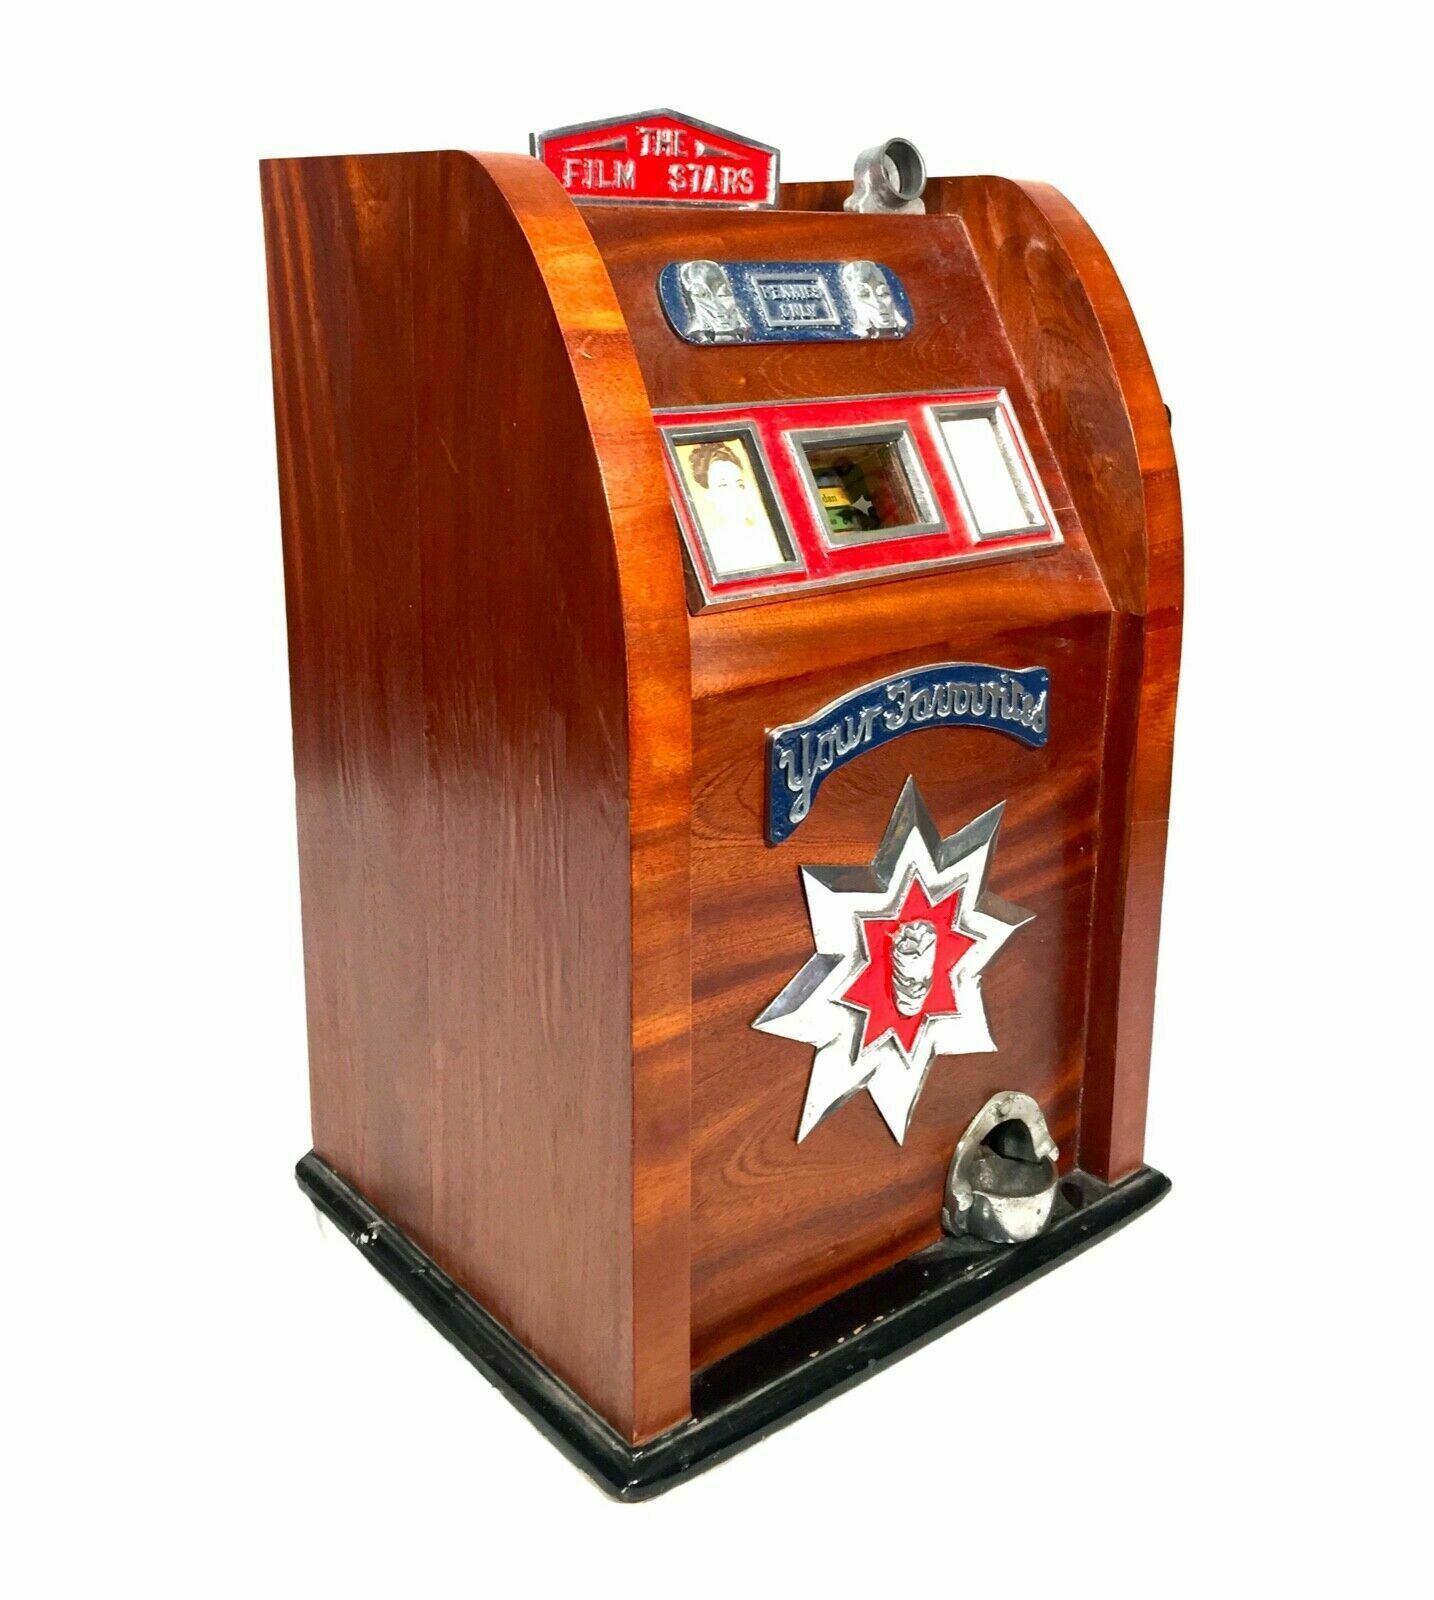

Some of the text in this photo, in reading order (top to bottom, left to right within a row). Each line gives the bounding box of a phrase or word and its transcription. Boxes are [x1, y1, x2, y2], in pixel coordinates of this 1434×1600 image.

[636, 126, 688, 157] THE
[562, 158, 754, 194] FILM STARS
[760, 284, 821, 300] PENNIES
[780, 302, 816, 320] ONLY
[779, 674, 1047, 823] Your Favourites
